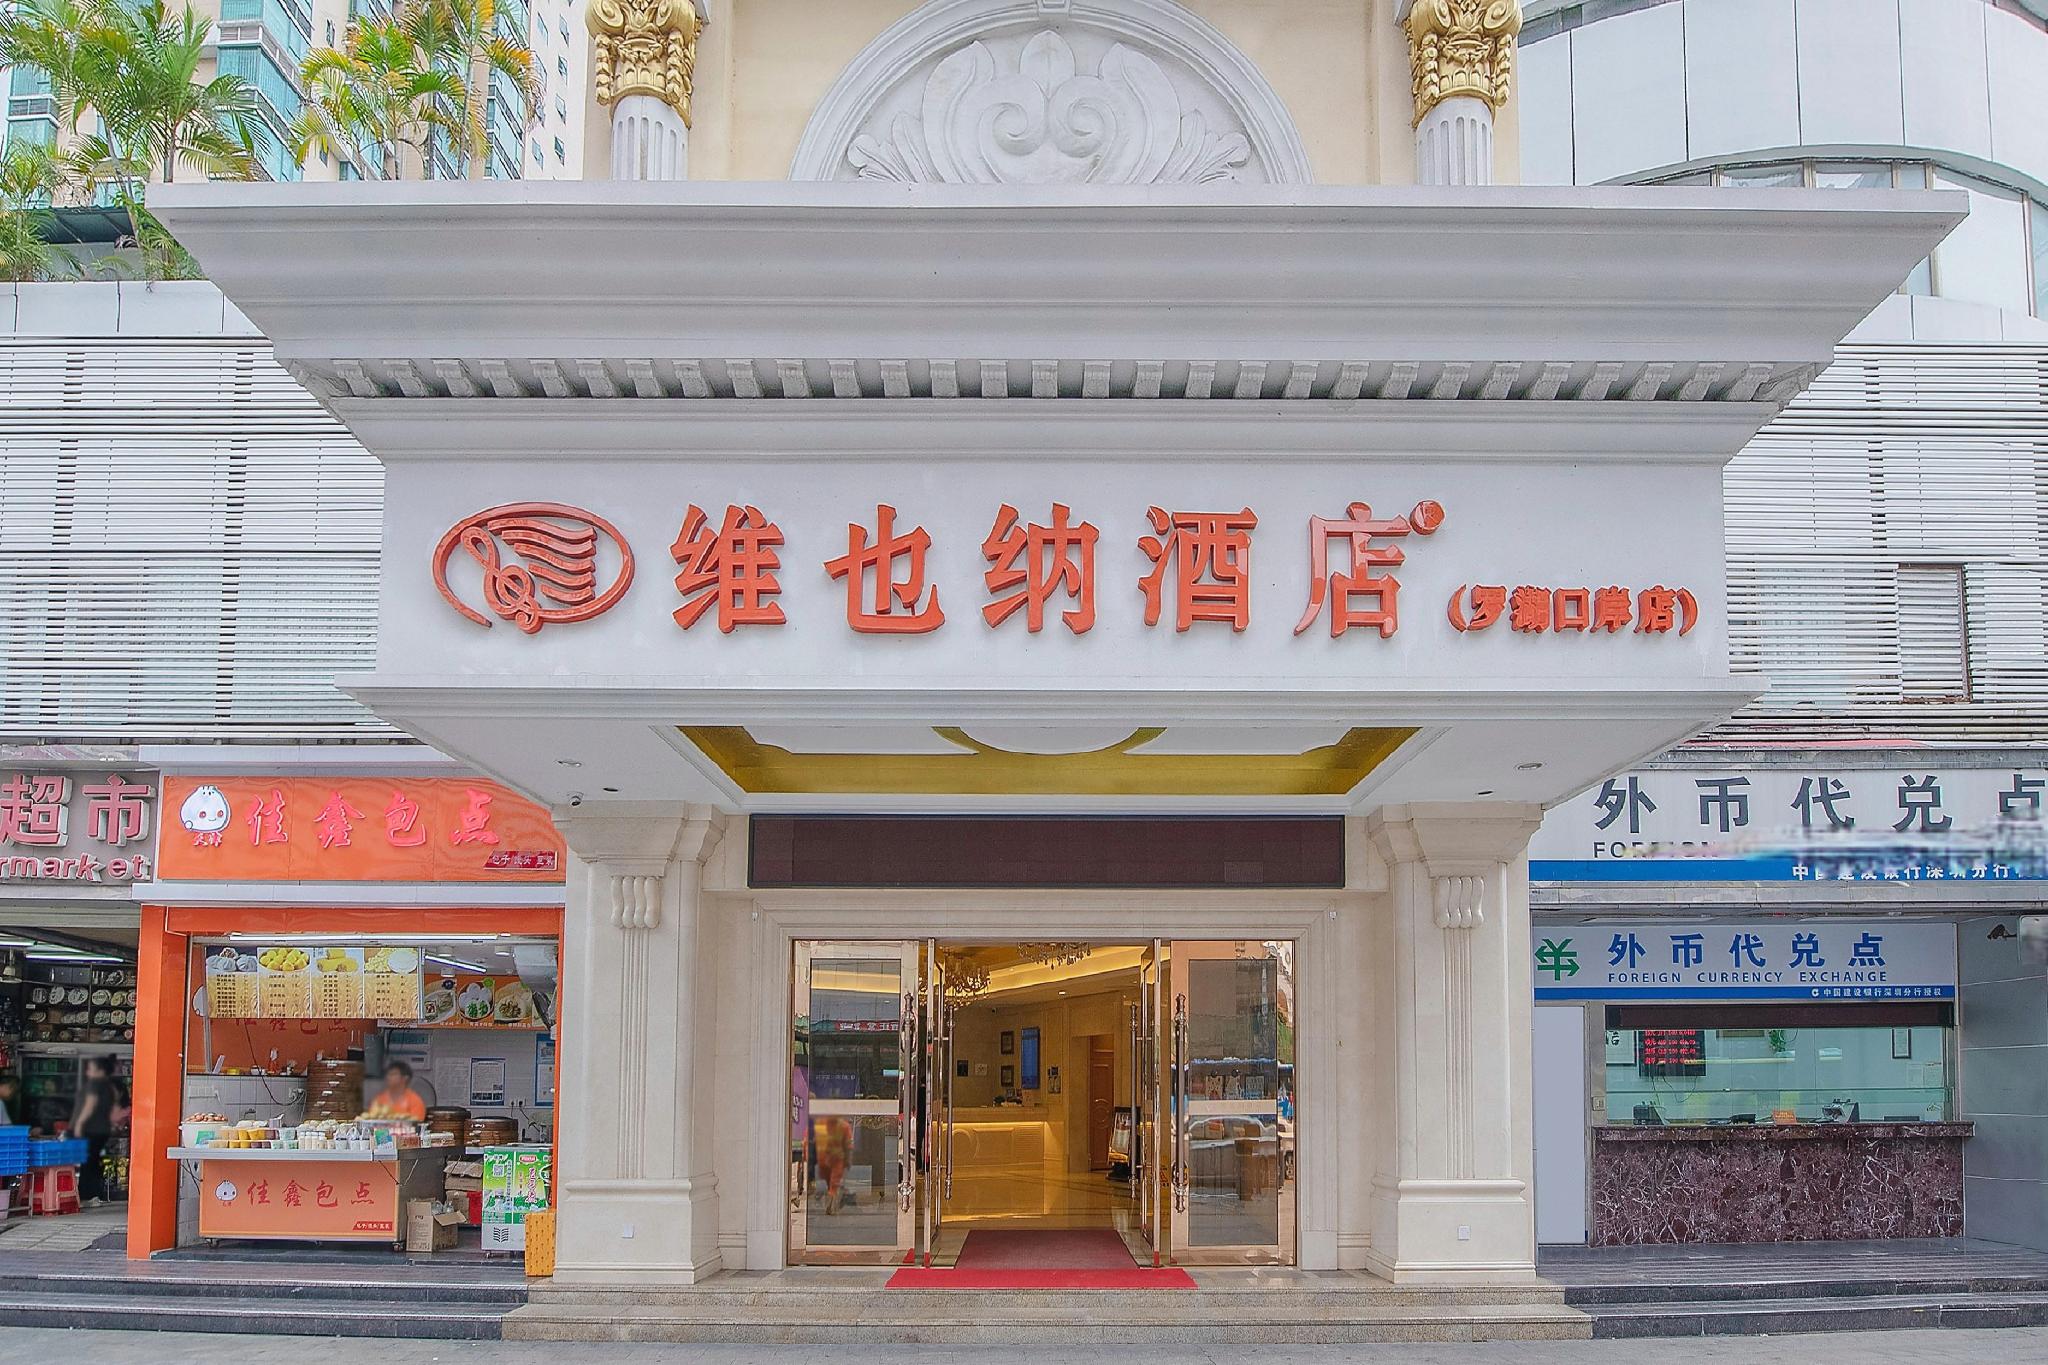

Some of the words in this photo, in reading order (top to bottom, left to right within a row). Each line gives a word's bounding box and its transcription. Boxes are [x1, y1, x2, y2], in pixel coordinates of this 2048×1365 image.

[671, 501, 1410, 639] 维也纳酒店
[0, 773, 153, 847] 超市
[247, 788, 500, 850] 佳鑫包点
[1608, 932, 1886, 969] 外币代兑点
[1608, 972, 1681, 984] FOREIGN
[1697, 972, 1783, 984] CURRENCY
[1799, 971, 1887, 983] EXCHANGE
[247, 1179, 375, 1208] 佳鑫包点
